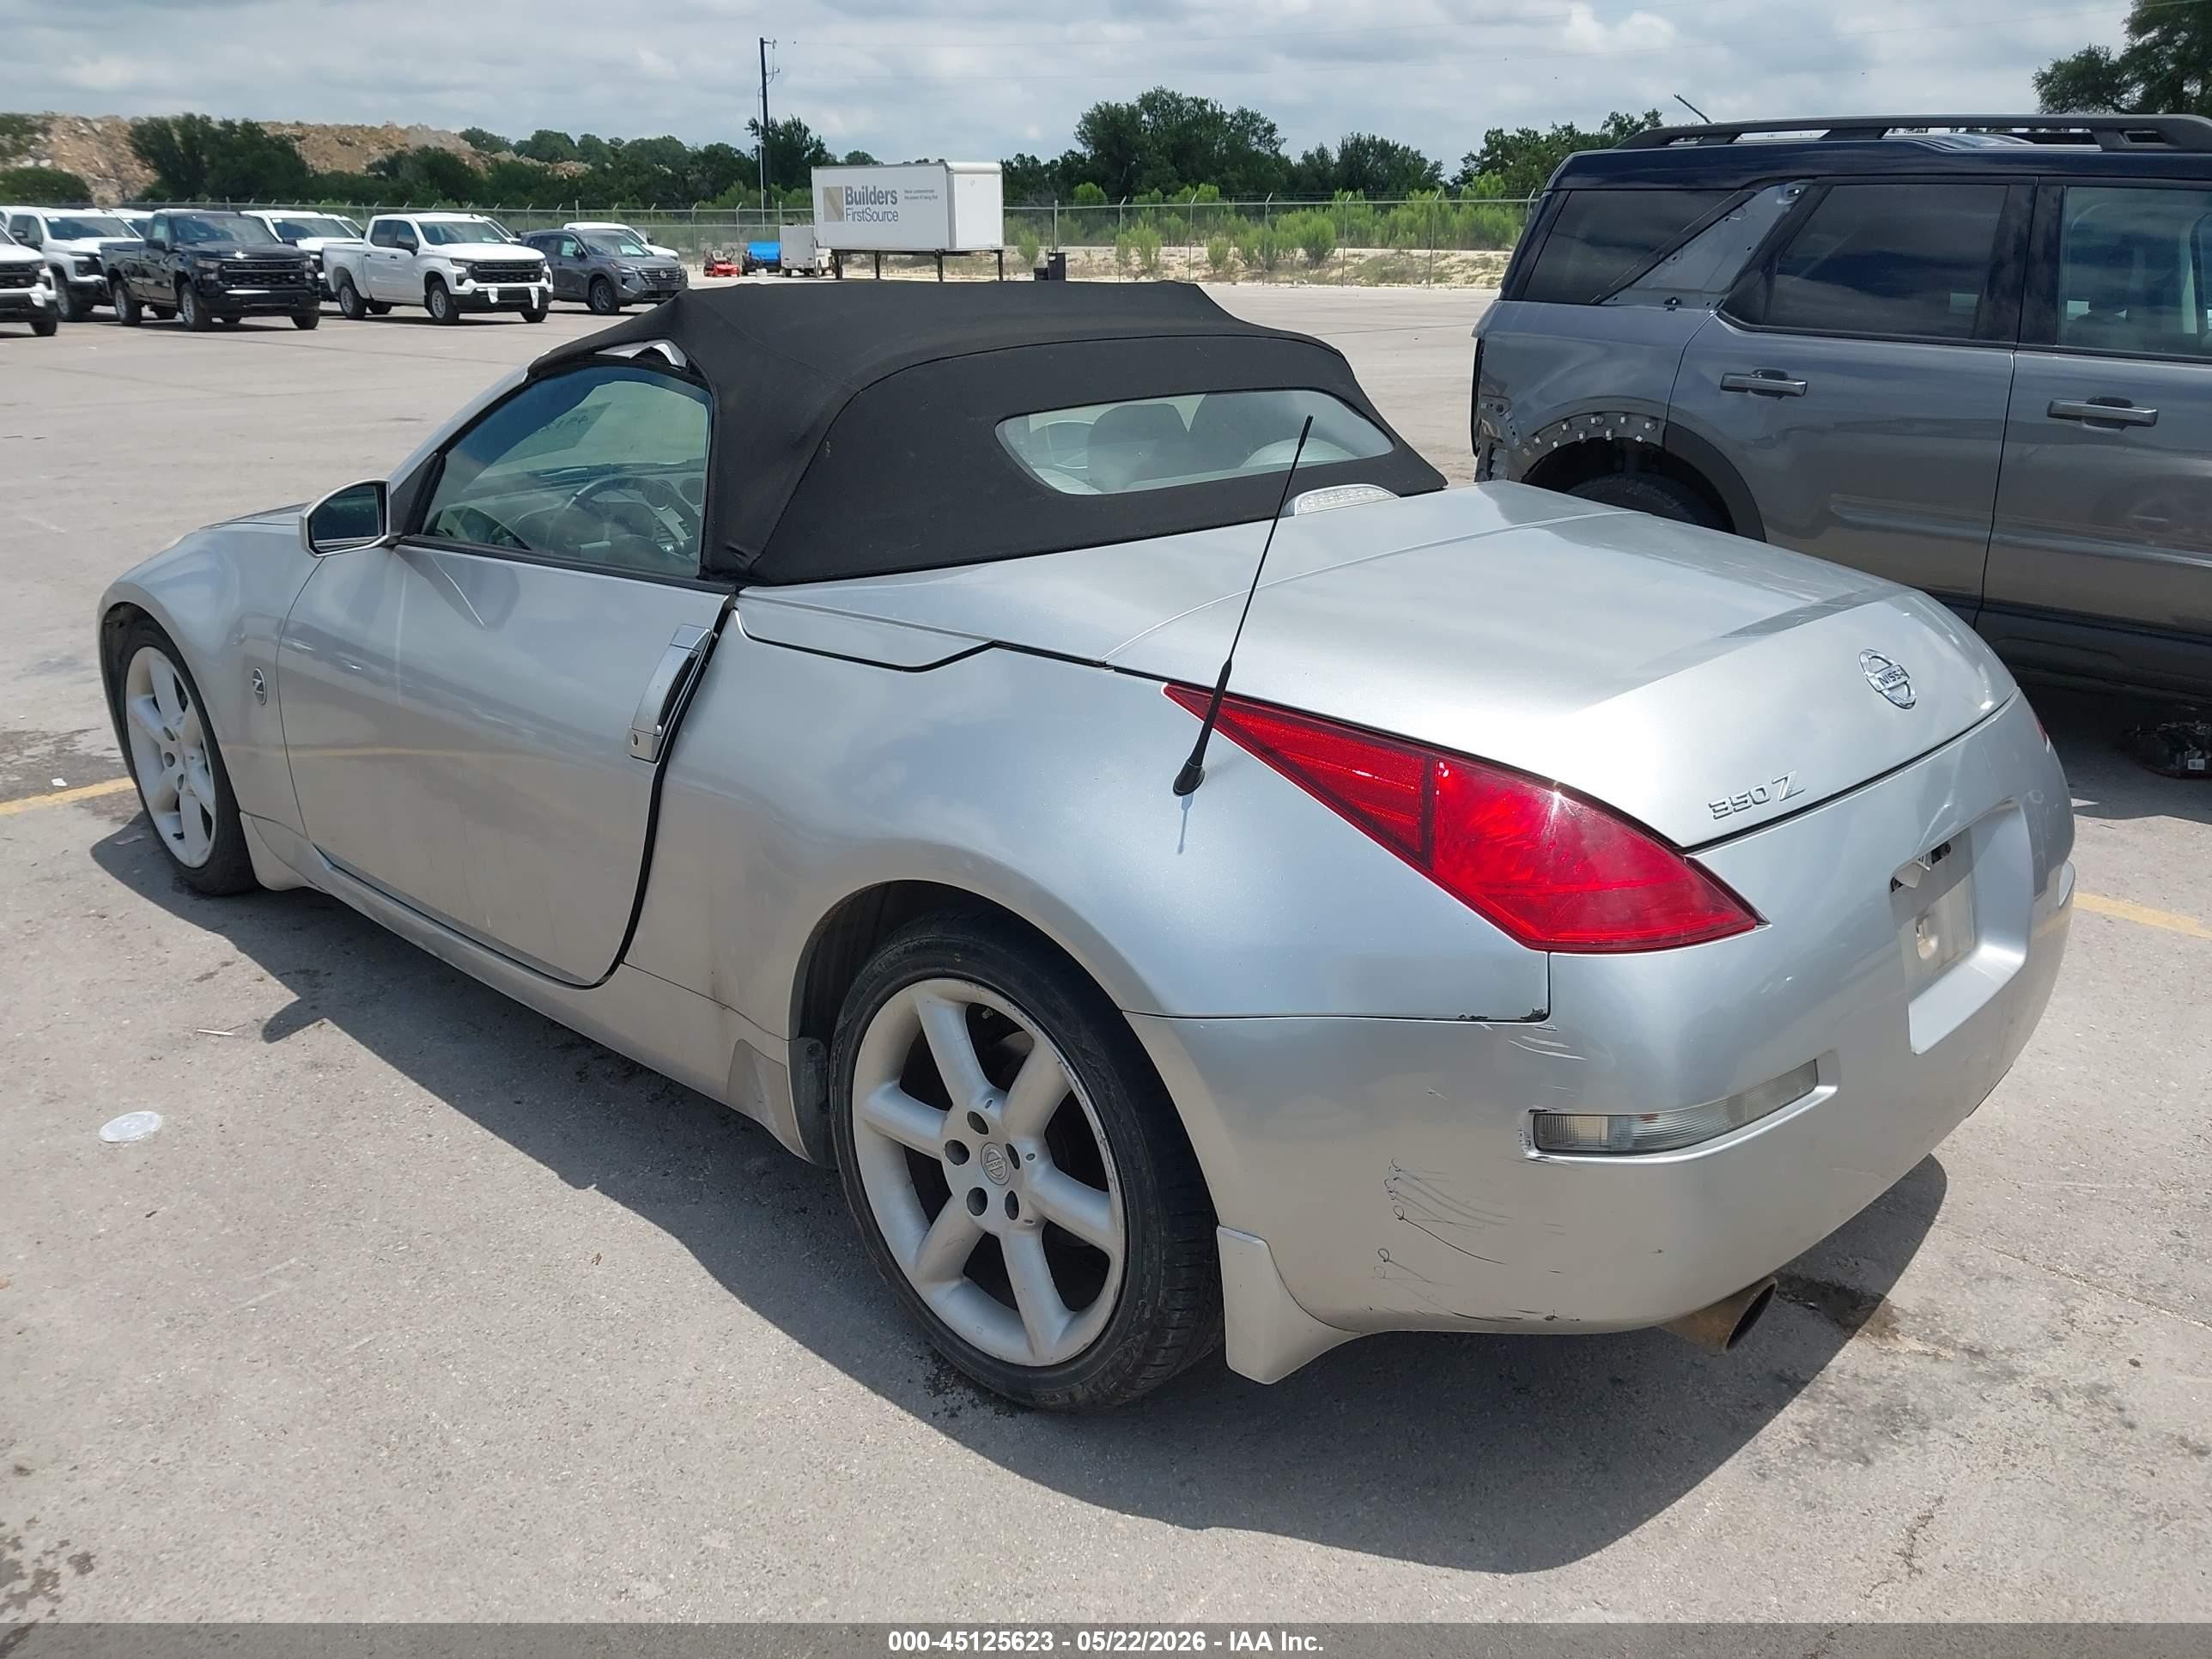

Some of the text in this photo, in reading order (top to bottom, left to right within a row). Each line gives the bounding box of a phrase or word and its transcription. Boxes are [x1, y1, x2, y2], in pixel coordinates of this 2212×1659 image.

[845, 185, 898, 205] Builders
[845, 207, 899, 222] FirstSource
[1877, 667, 1907, 686] NISSA
